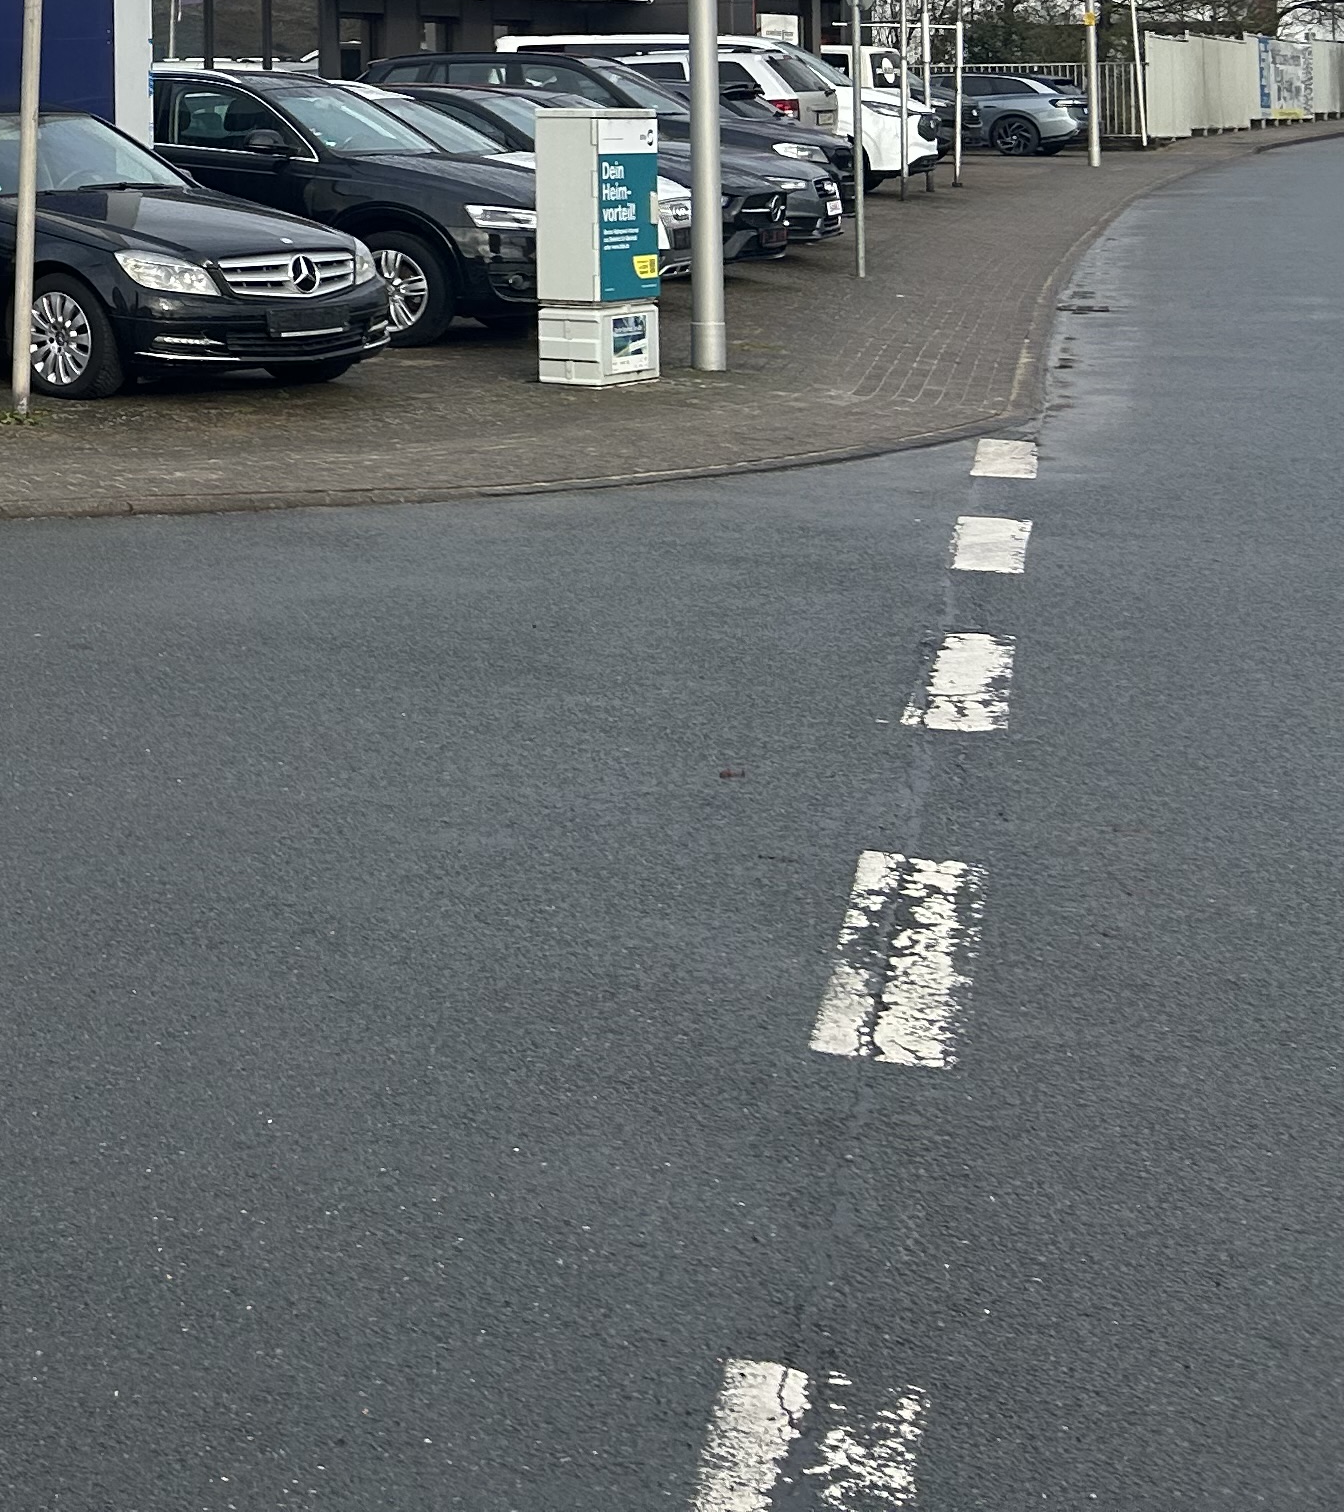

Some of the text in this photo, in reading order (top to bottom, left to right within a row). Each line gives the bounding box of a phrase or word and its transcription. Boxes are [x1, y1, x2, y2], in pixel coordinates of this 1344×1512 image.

[602, 161, 624, 179] Dein
[602, 182, 631, 200] Heim-
[602, 203, 636, 222] vorteil!
